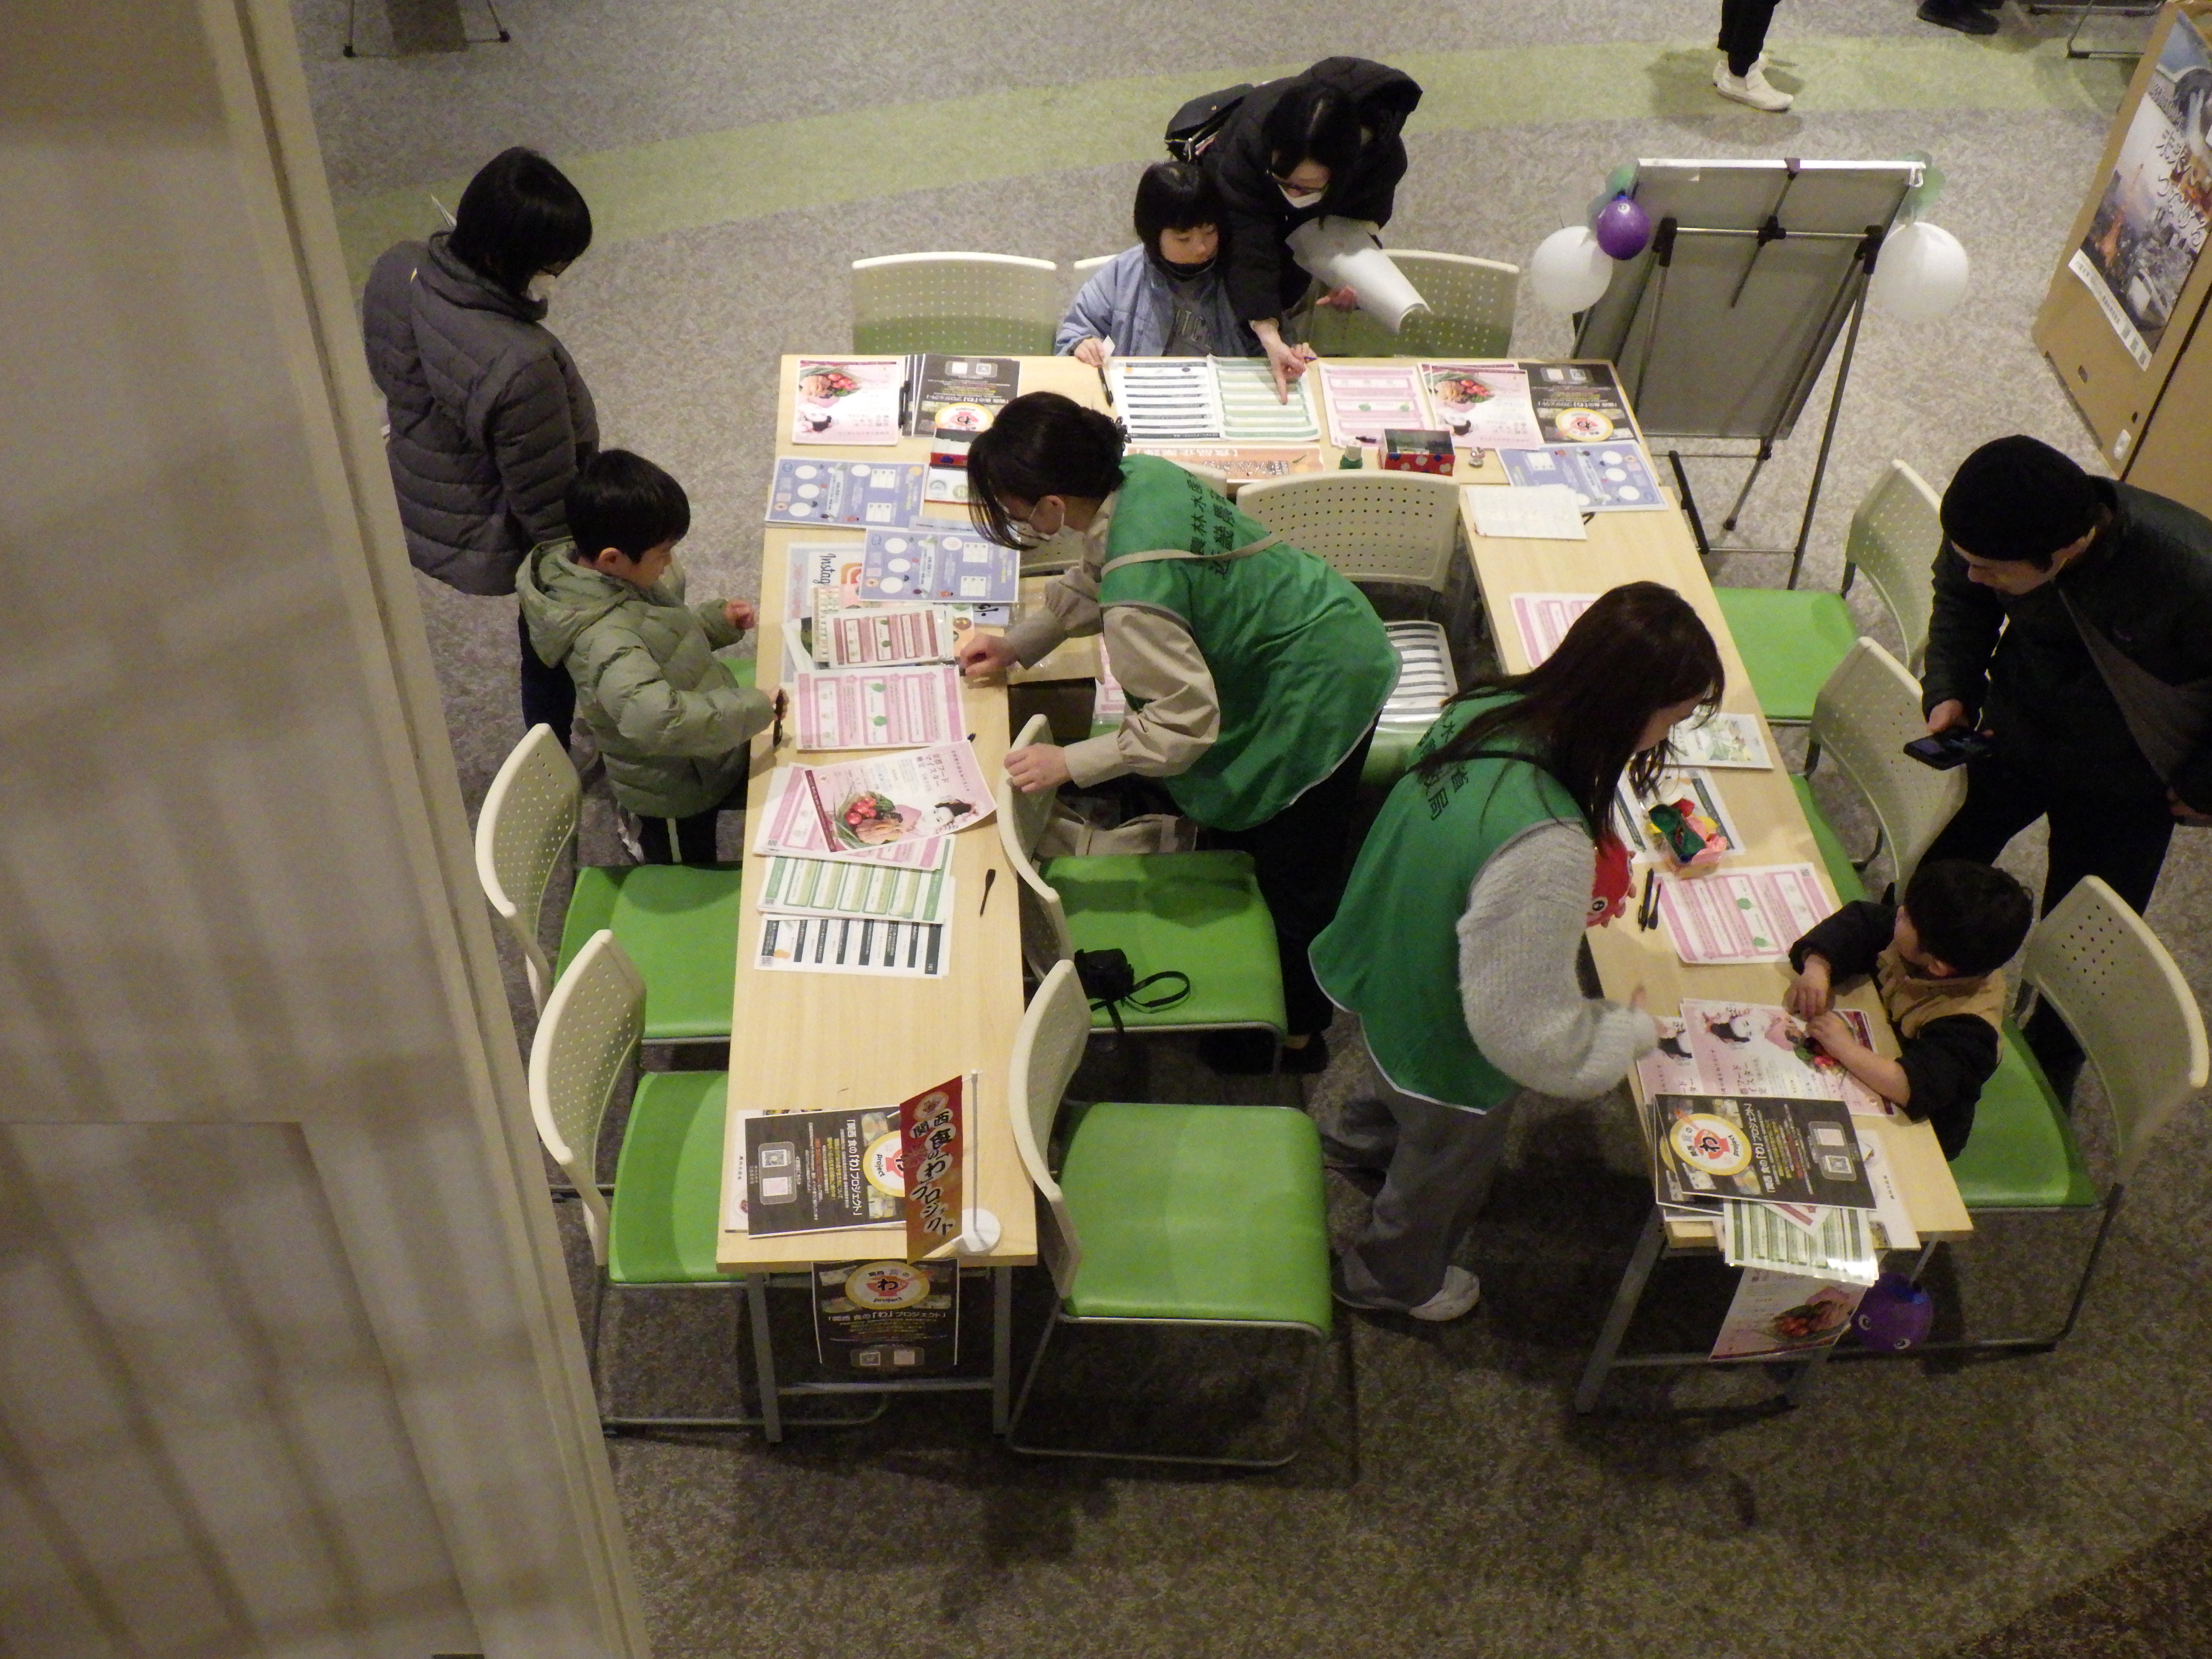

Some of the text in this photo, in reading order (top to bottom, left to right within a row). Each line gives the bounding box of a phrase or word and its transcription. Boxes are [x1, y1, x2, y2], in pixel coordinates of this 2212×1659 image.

[2157, 175, 2210, 247] つなげる
[1700, 1136, 1721, 1152] わ
[874, 1153, 885, 1177] project
[877, 1278, 899, 1291] わ
